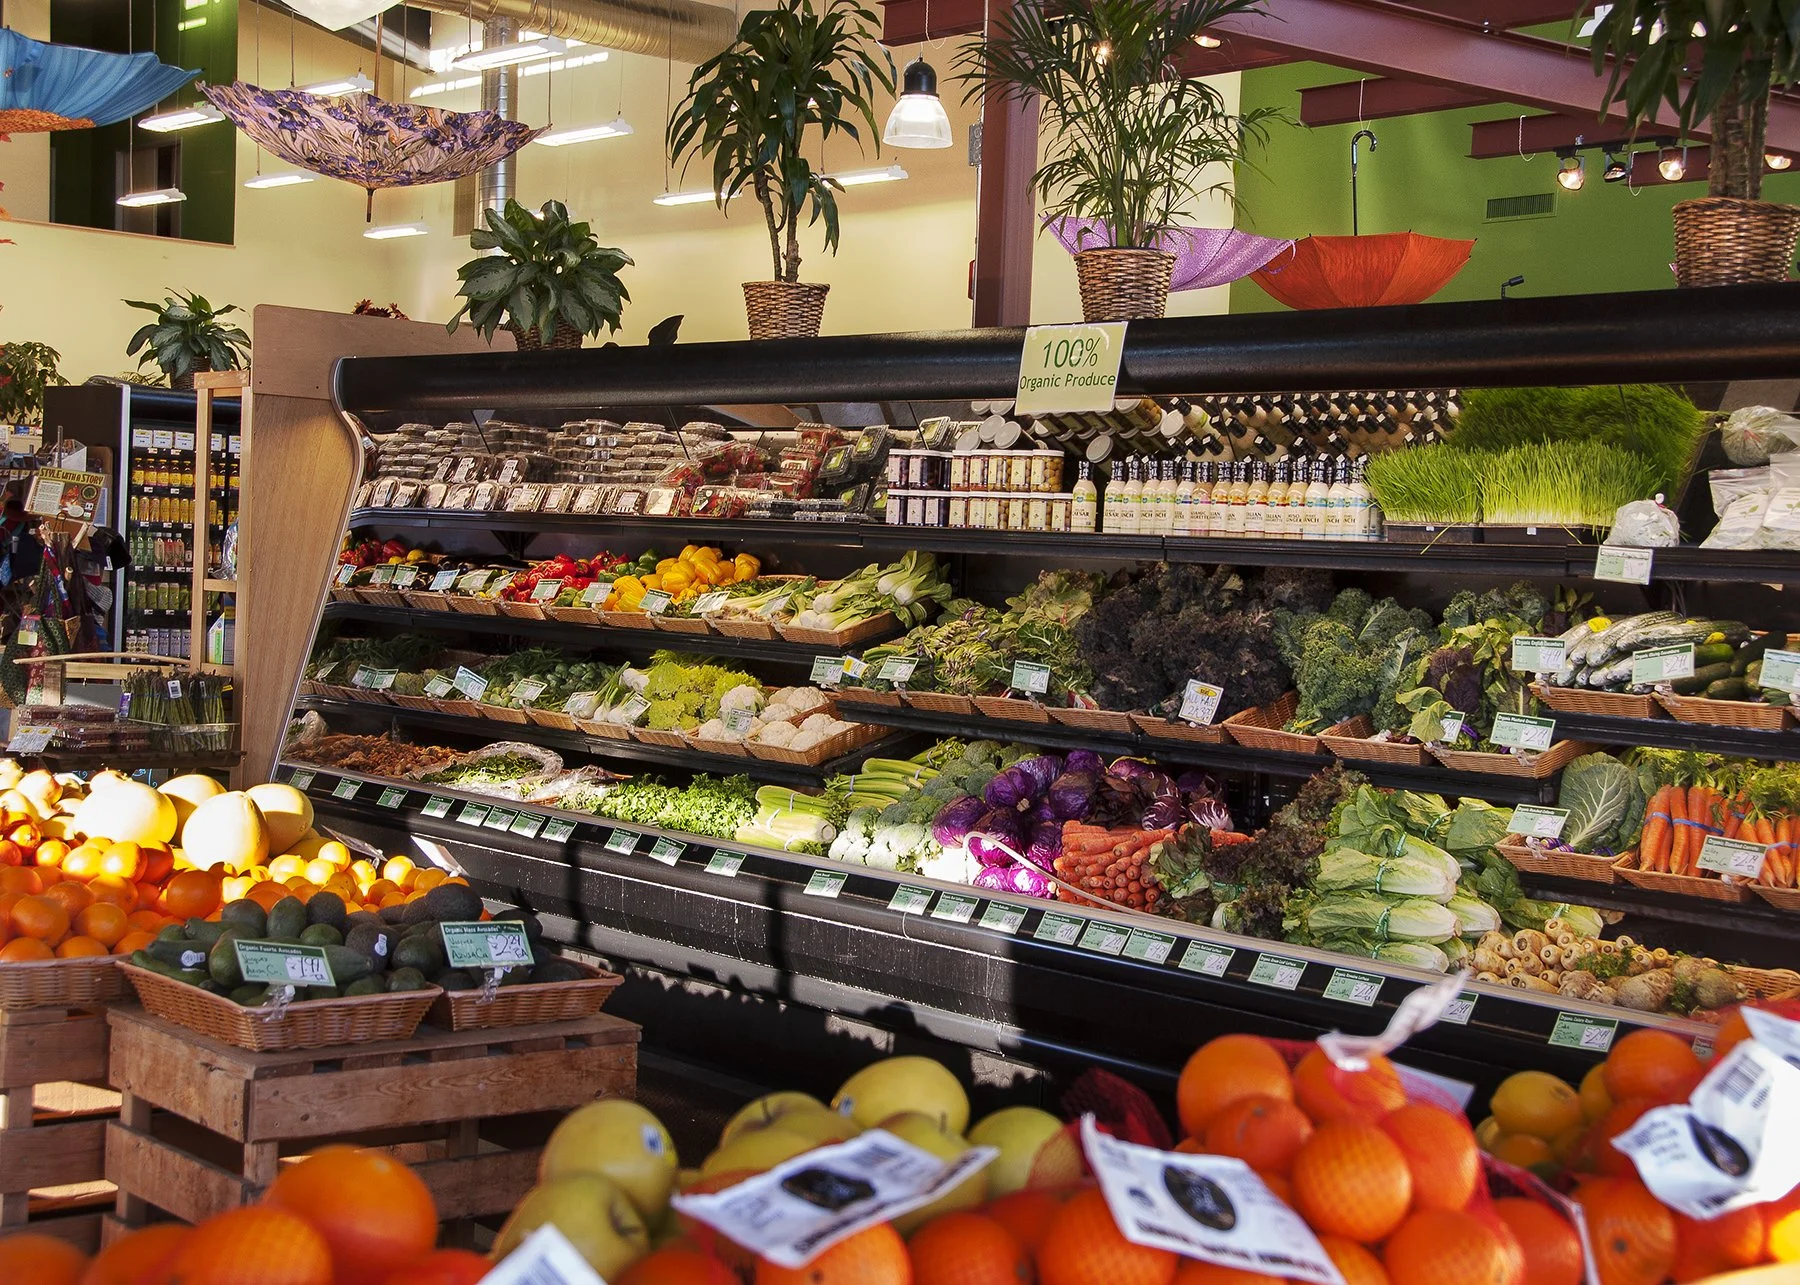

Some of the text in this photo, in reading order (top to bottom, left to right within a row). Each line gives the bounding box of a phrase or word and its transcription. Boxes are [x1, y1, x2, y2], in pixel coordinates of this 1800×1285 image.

[1044, 337, 1101, 368] 100%
[1020, 372, 1116, 391] Organic Produce
[40, 468, 62, 479] STYLE
[62, 472, 77, 482] WITH
[81, 474, 104, 485] STORY
[239, 944, 259, 952] Organic
[259, 945, 277, 953] Fuerte
